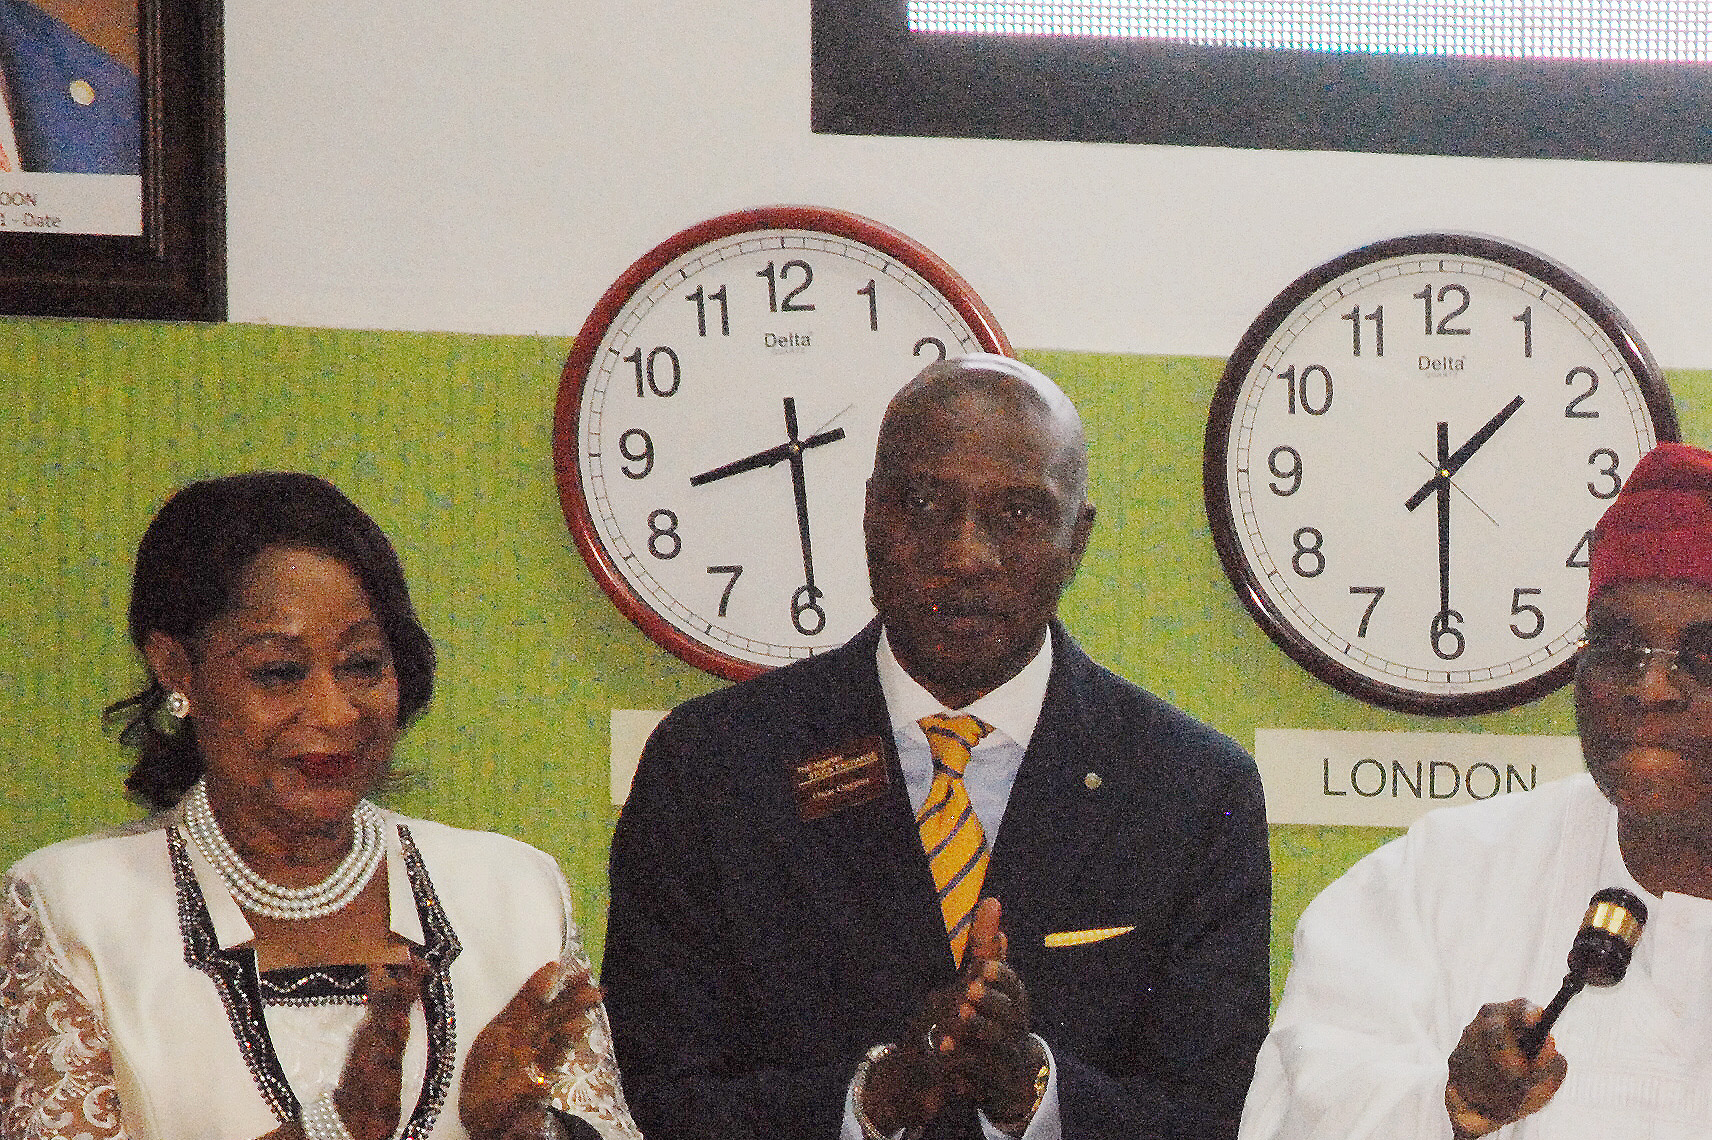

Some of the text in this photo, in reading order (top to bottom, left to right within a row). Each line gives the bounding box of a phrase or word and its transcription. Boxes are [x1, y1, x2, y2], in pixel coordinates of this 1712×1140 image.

[23, 212, 61, 228] Date
[685, 285, 730, 336] 11
[757, 260, 815, 312] 12
[857, 279, 878, 331] 1
[1413, 284, 1470, 335] 12
[764, 332, 811, 348] Delta
[1341, 304, 1384, 357] 11
[1513, 306, 1532, 358] 1
[624, 346, 681, 397] 10
[1418, 355, 1464, 371] Delta
[1277, 365, 1333, 415] 10
[1564, 367, 1599, 418] 2
[619, 429, 654, 479] 9
[1267, 445, 1302, 496] 9
[1587, 449, 1622, 499] 3
[647, 509, 681, 559] 8
[1292, 527, 1325, 577] 8
[707, 564, 743, 617] 7
[790, 585, 826, 635] 6
[1349, 586, 1385, 637] 7
[1510, 588, 1545, 638] 5
[1430, 609, 1465, 660] 6
[1323, 757, 1537, 800] LONDON
